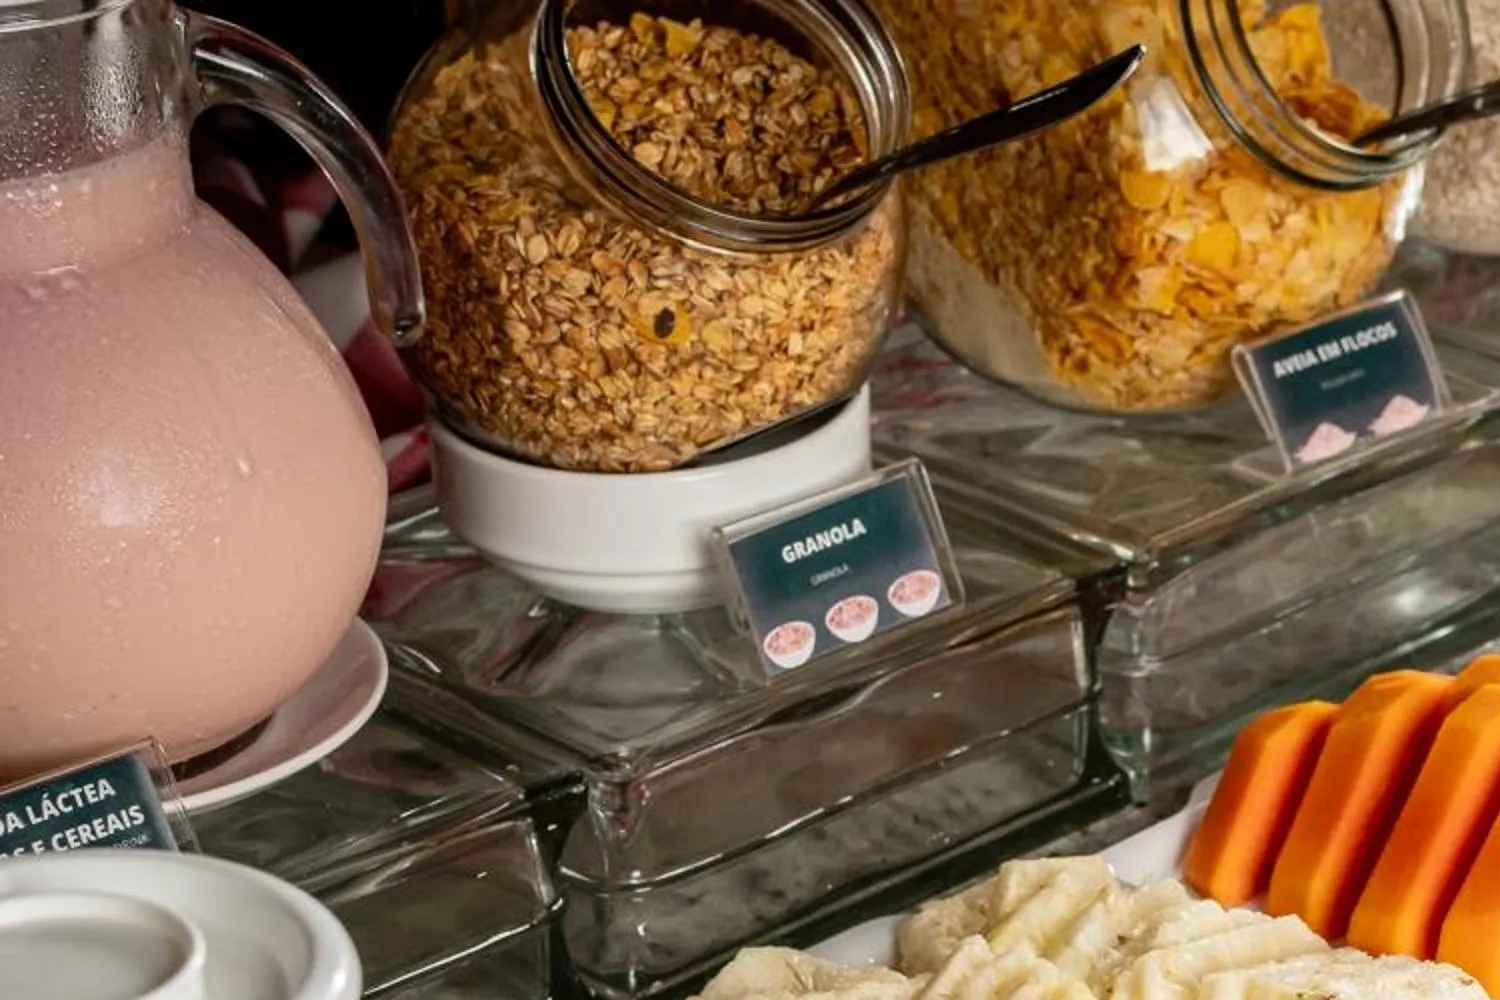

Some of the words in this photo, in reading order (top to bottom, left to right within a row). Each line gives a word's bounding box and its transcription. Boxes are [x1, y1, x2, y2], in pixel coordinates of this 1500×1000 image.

[781, 517, 868, 564] GRANOLA
[25, 778, 117, 825] LÁCTEA
[51, 804, 146, 851] CEREAIS
